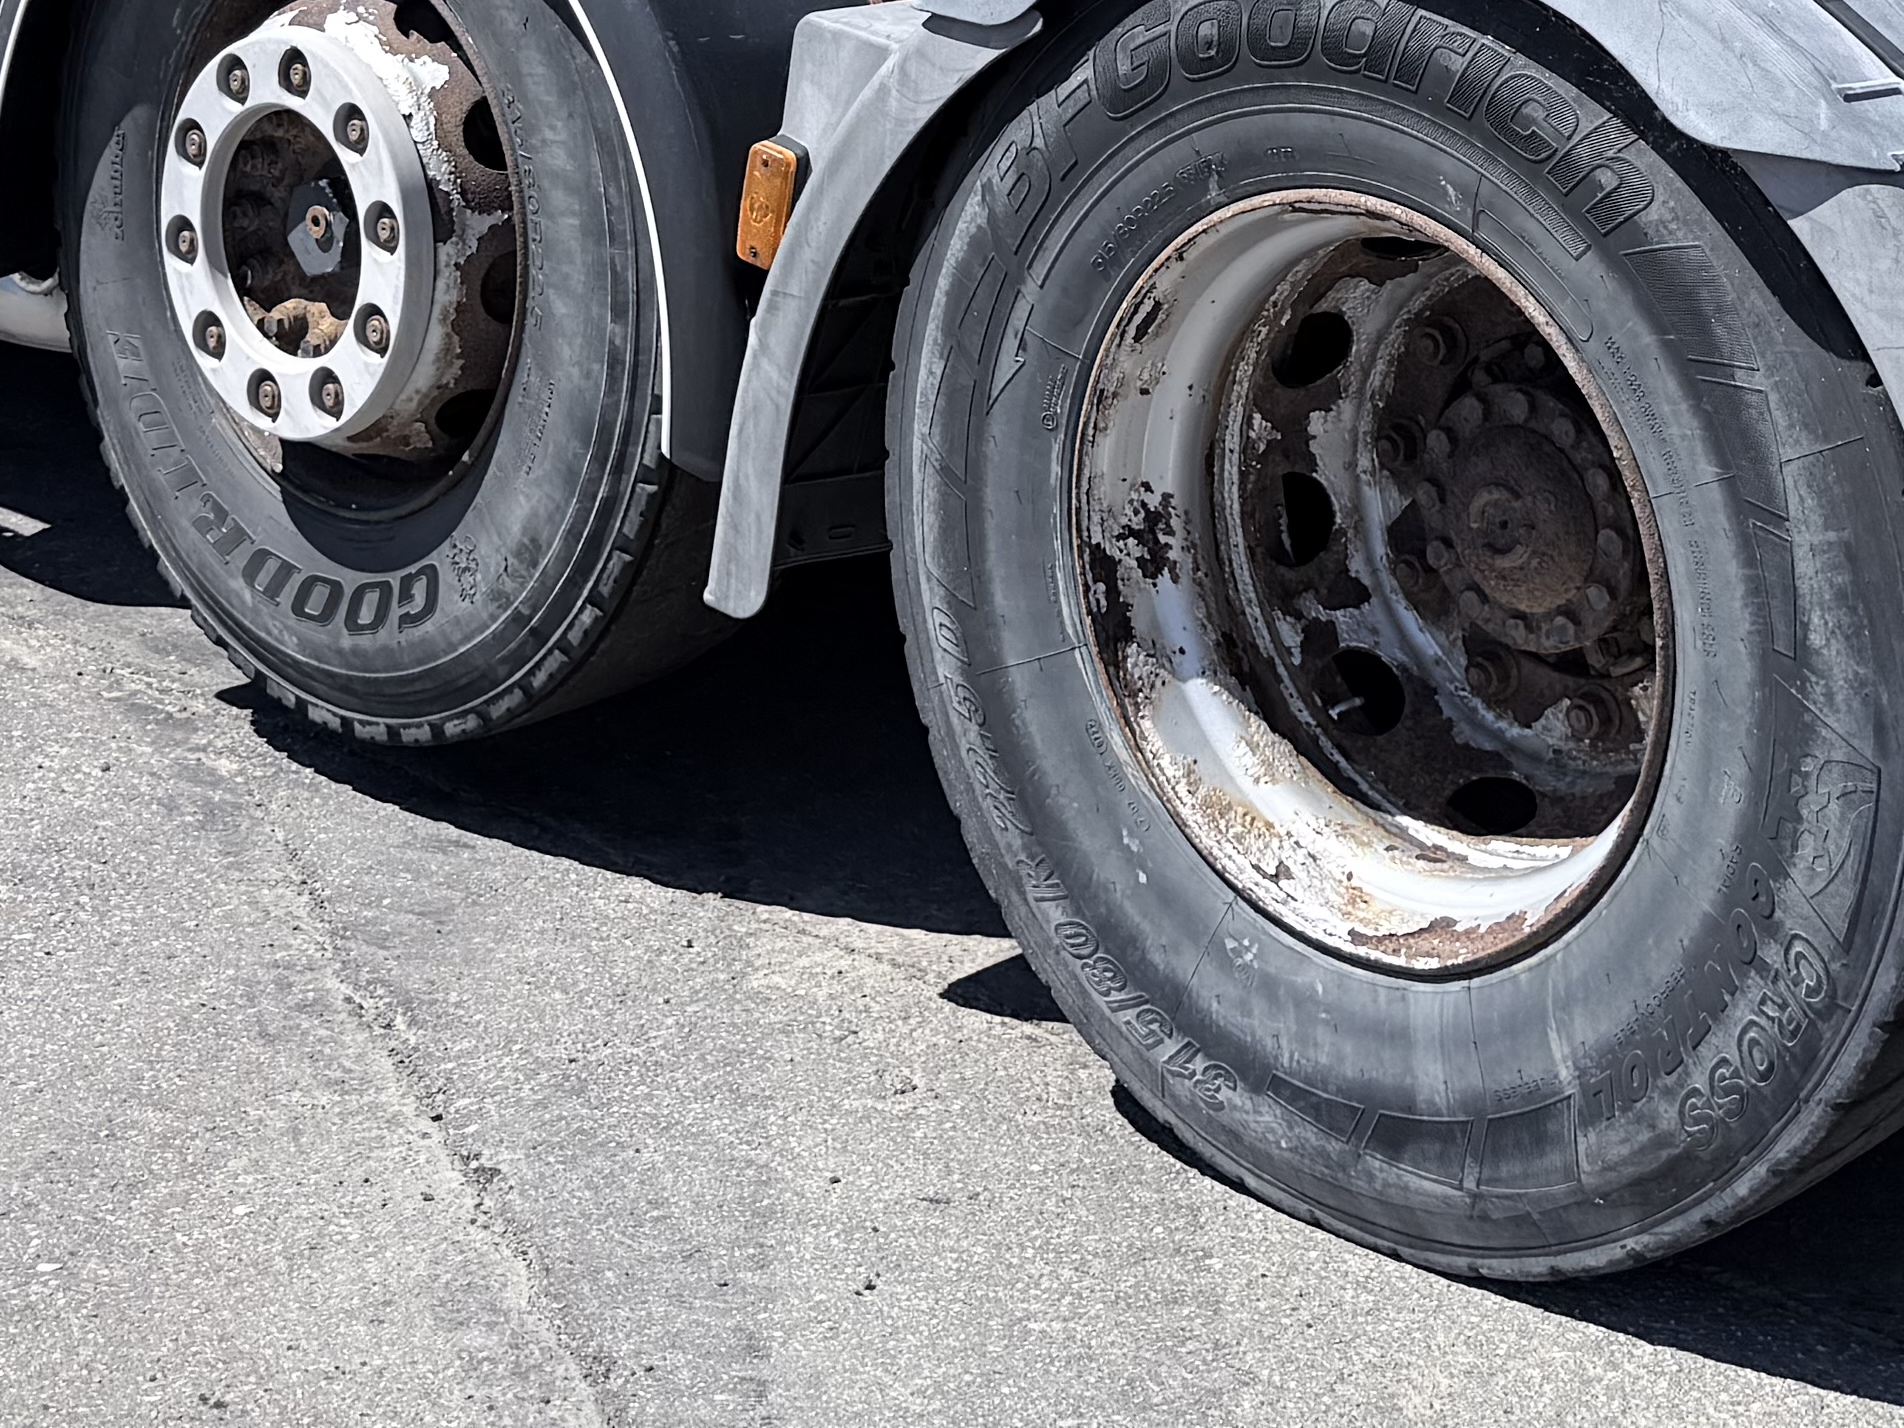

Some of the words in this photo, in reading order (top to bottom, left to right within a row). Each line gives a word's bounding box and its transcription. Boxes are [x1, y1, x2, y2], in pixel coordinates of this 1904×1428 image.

[104, 328, 442, 635] GOODRIDE
[1049, 911, 1239, 1118] 315/80
[1585, 858, 1779, 1127] CONTROL
[1667, 926, 1839, 1158] CROSS
